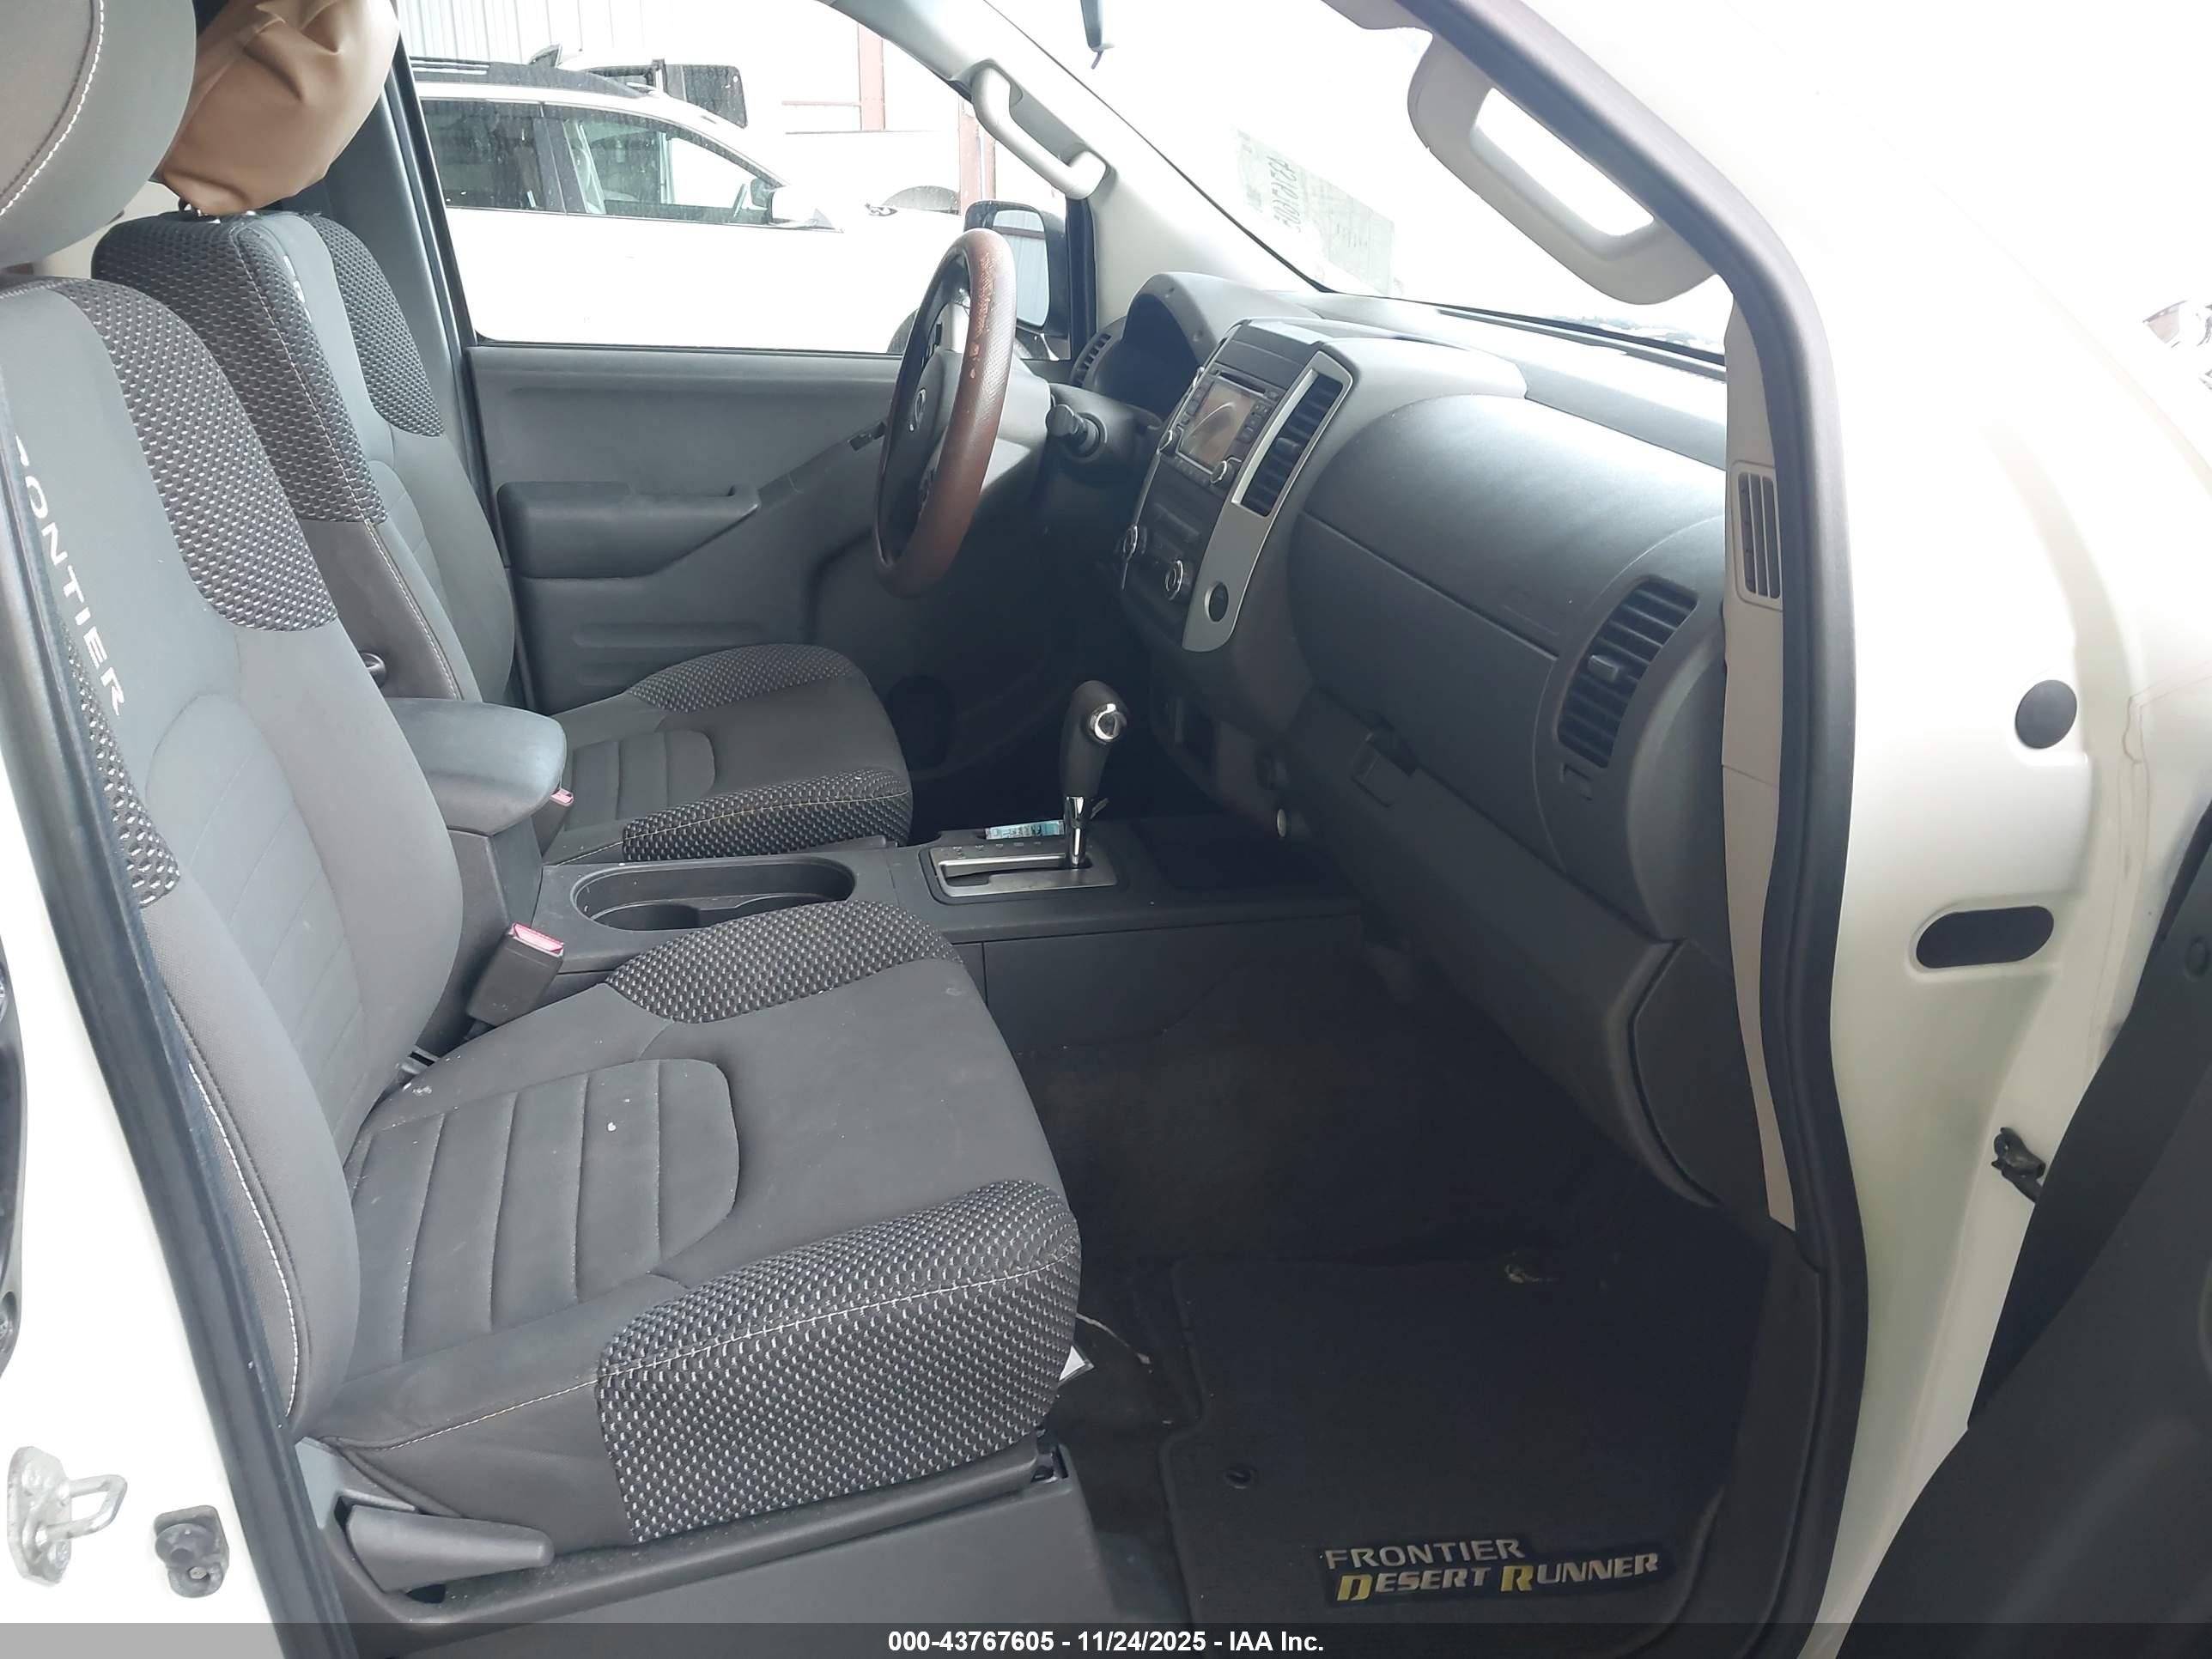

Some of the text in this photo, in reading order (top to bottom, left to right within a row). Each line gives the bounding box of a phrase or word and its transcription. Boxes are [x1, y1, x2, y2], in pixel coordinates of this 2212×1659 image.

[15, 433, 125, 717] ONTIER
[1325, 1539, 1526, 1571] FRONTIER
[1336, 1553, 1659, 1602] DESERT RUNNER
